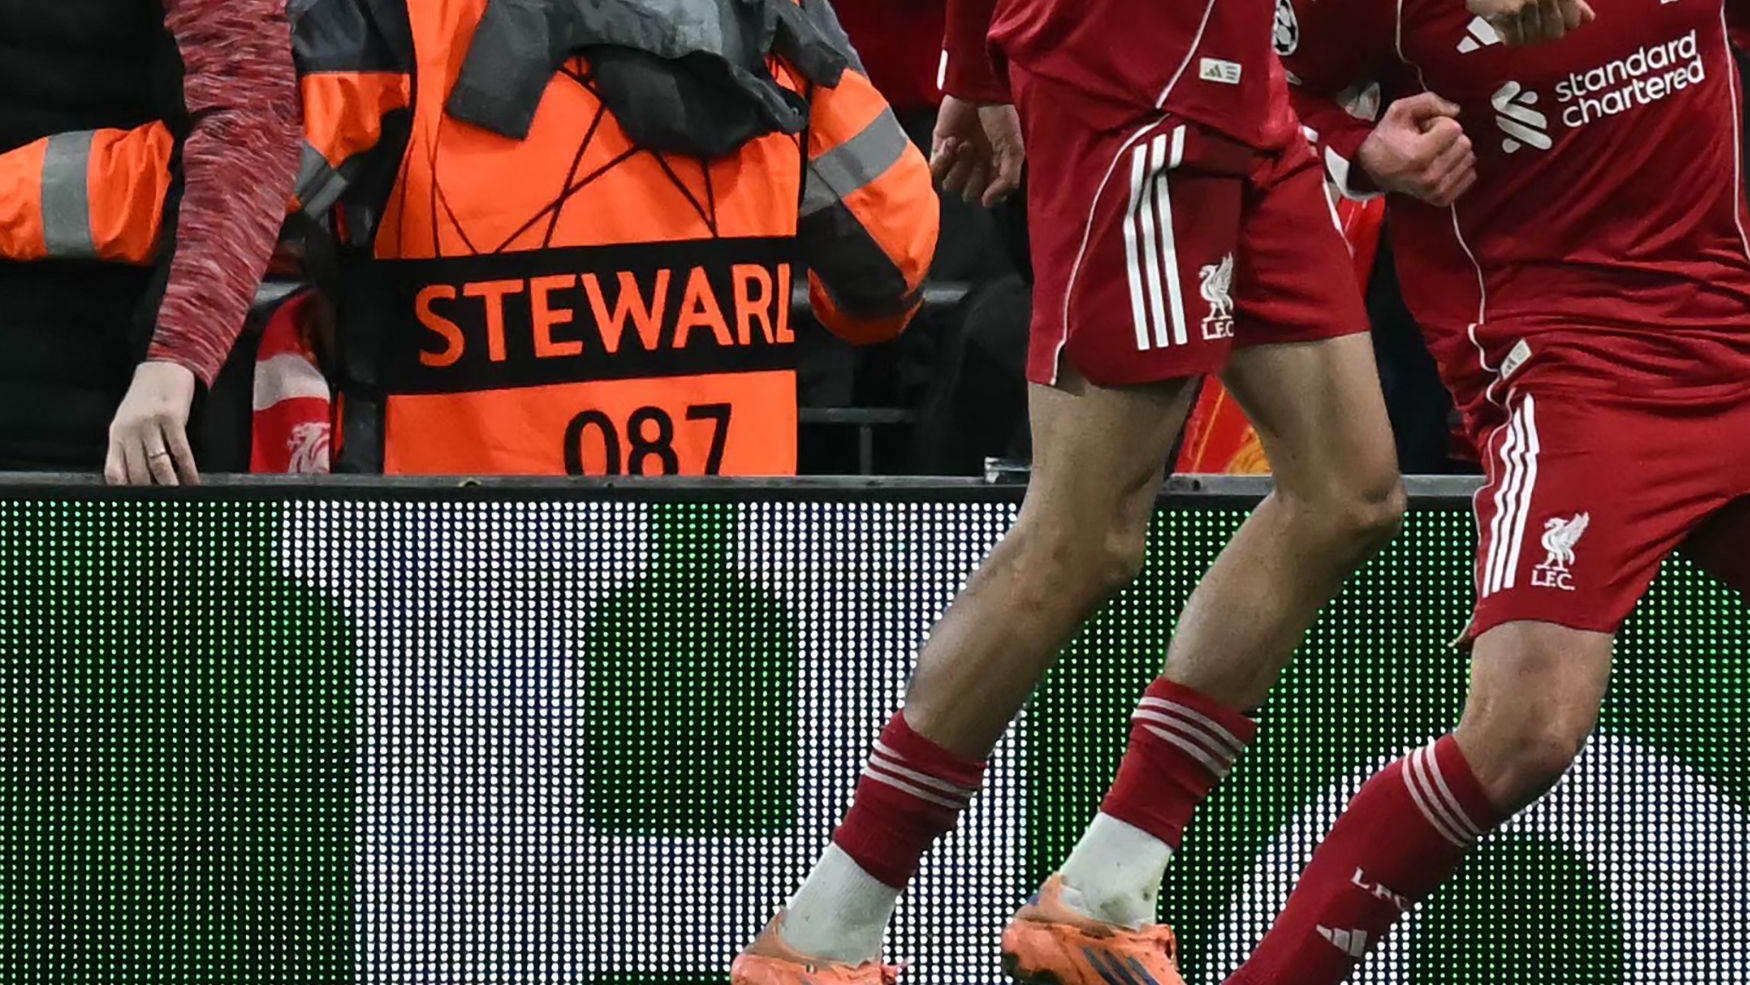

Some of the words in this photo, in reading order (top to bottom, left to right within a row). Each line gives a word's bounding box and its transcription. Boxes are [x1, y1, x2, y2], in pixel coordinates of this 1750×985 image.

[1555, 29, 1697, 102] standard
[1563, 53, 1705, 127] chartered
[563, 402, 733, 476] 087
